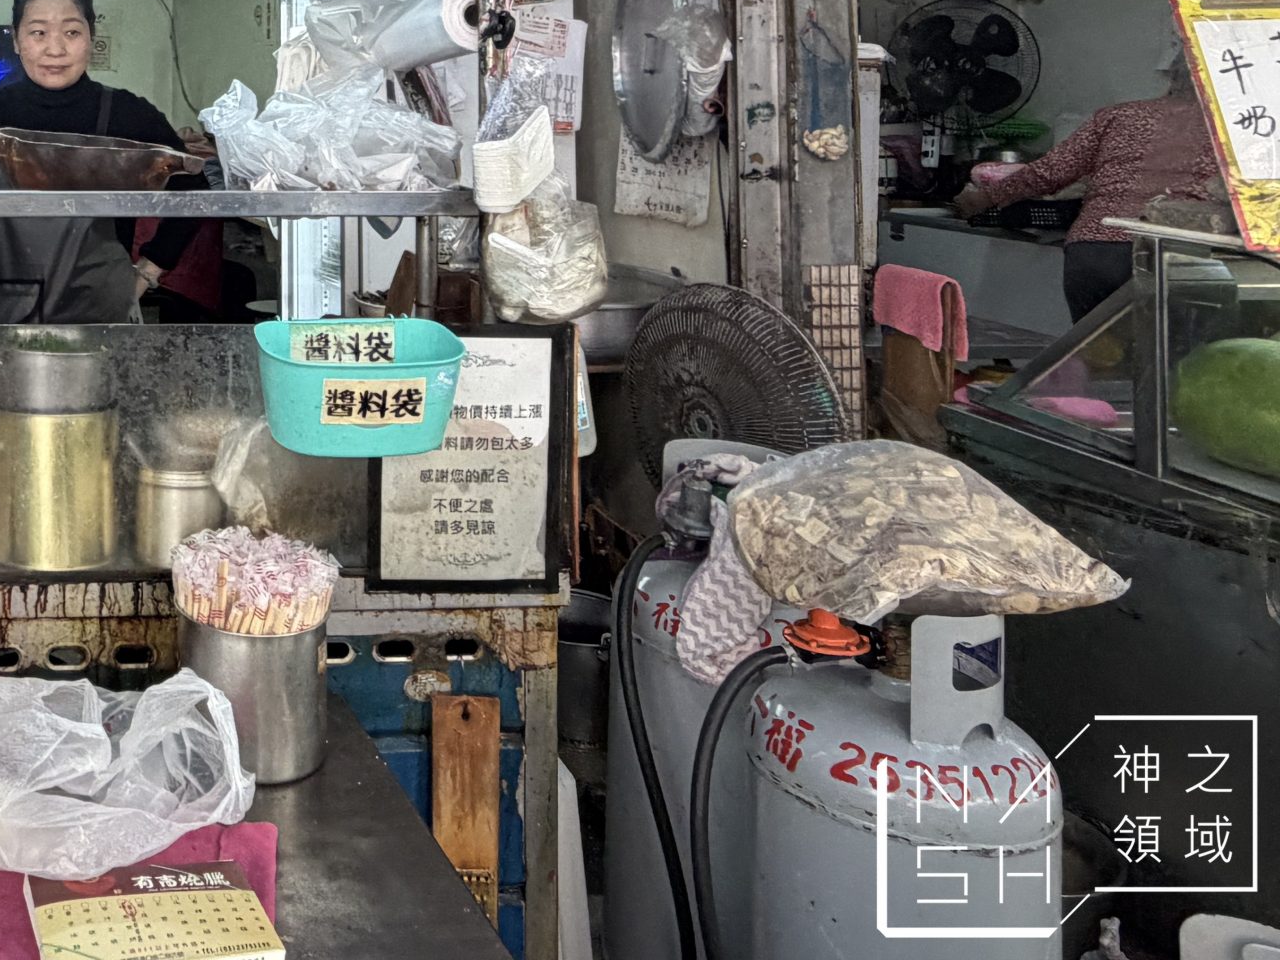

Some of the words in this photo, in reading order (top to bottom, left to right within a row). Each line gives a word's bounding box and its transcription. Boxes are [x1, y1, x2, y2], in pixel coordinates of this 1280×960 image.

[1219, 48, 1276, 137] 牛奶
[304, 331, 395, 363] 醬料袋
[324, 388, 424, 419] 醬料袋
[450, 404, 543, 420] 物價持續上漲
[438, 436, 534, 452] 料請勿包太多
[420, 468, 510, 484] 感謝您的配合
[433, 498, 494, 514] 不便之處
[434, 520, 496, 536] 請多見諒
